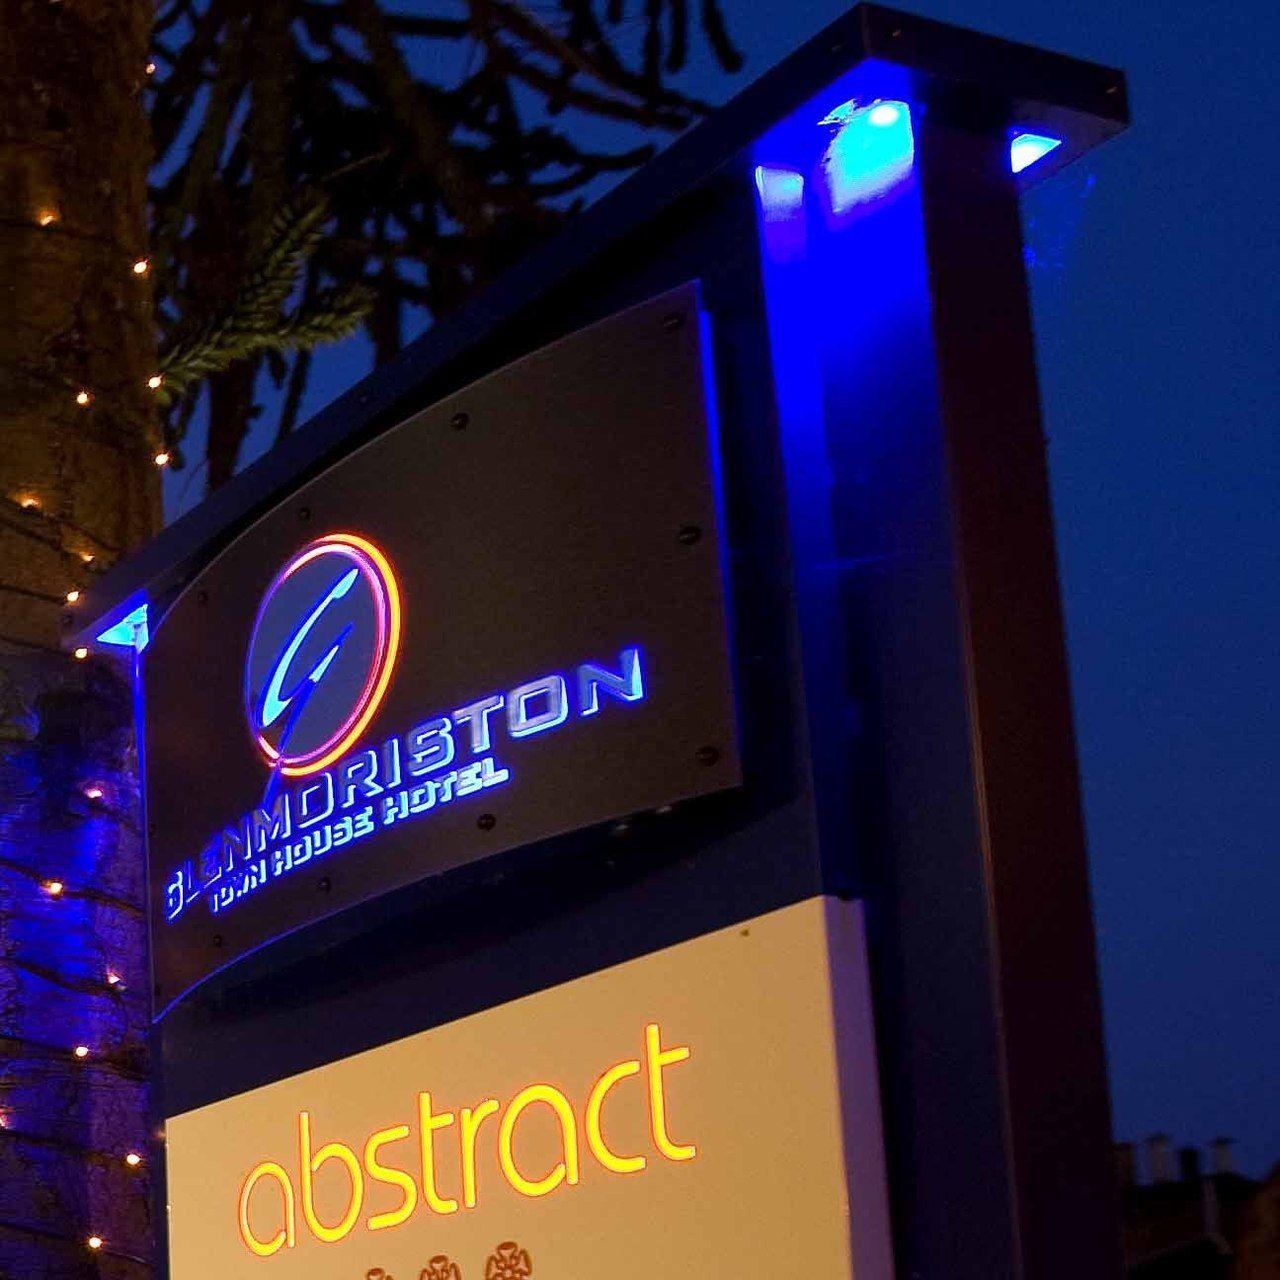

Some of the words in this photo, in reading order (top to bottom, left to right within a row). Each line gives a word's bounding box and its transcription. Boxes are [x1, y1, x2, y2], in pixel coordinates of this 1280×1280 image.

[164, 645, 646, 922] GLENMORISTON
[270, 804, 376, 878] HOUSE
[381, 755, 512, 827] HOTEL
[238, 1022, 698, 1257] abstract
